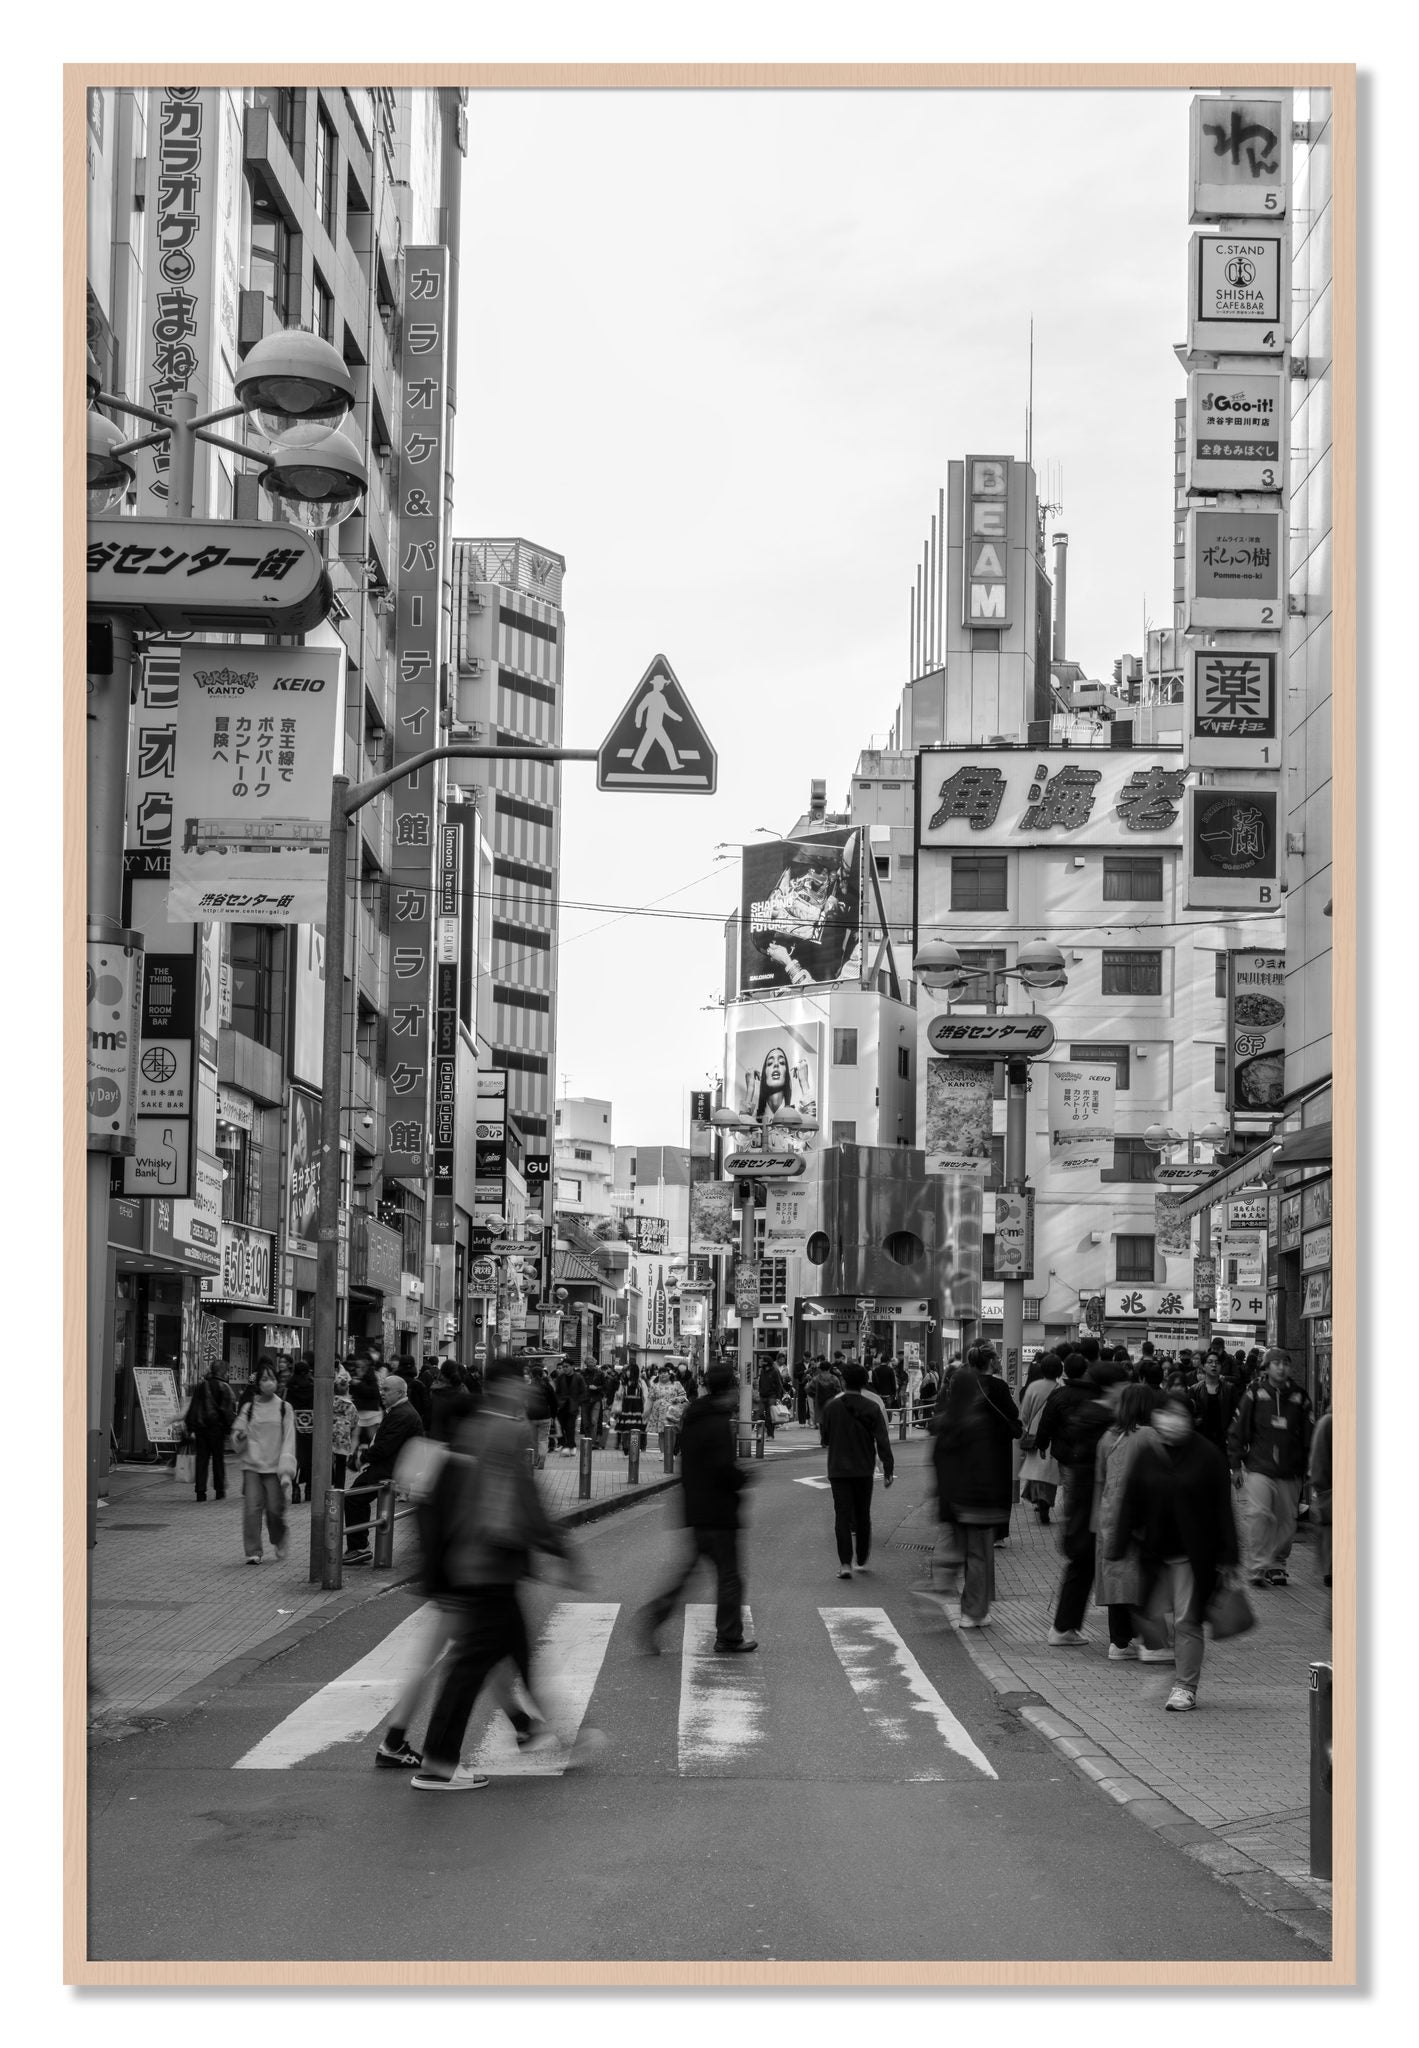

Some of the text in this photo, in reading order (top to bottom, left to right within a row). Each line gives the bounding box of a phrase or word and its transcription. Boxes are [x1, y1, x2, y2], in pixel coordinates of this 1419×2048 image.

[1264, 193, 1278, 210] 5
[1216, 245, 1265, 255] C.STAND
[1216, 289, 1265, 301] SHISHA
[1216, 301, 1265, 310] CAFE&BAR
[1262, 331, 1276, 347] 4
[1214, 395, 1273, 412] Goo-it!
[1206, 416, 1270, 427] 渋谷宇田川町店
[1201, 444, 1275, 457] 全身もみほぐし
[1261, 468, 1275, 486] 3
[971, 460, 1007, 617] BEAM
[1202, 546, 1272, 568] ポムの樹
[1213, 571, 1263, 580] Pomme-no-ki
[1261, 607, 1274, 624] 2
[207, 686, 245, 695] KANTO
[273, 677, 326, 692] KEIO
[1205, 660, 1261, 716] 薬
[212, 716, 230, 763] 冒険へ
[232, 716, 252, 798] カントーの
[254, 716, 275, 799] ポケパーク
[277, 717, 297, 782] 京王線で
[1260, 746, 1269, 763] 1
[928, 764, 1190, 831] 角海老
[1200, 807, 1266, 860] 一蘭
[444, 829, 455, 910] kimono hearts
[198, 893, 295, 908] 渋谷センター街
[1259, 886, 1272, 903] B
[149, 975, 173, 983] THIRD
[153, 967, 170, 975] THE
[148, 1006, 172, 1014] ROOM
[442, 969, 455, 1050] disk union
[152, 1018, 168, 1026] BAR
[935, 1025, 1048, 1039] 渋谷センター街
[87, 1030, 128, 1051] me
[1235, 1034, 1266, 1057] 6F
[97, 1087, 119, 1103] Day!
[490, 1130, 503, 1138] UP
[136, 1158, 172, 1170] Whisky
[527, 1162, 549, 1173] GU
[728, 1158, 796, 1168] 渋谷センター街
[135, 1169, 157, 1177] Bank
[656, 1289, 666, 1335] BEER
